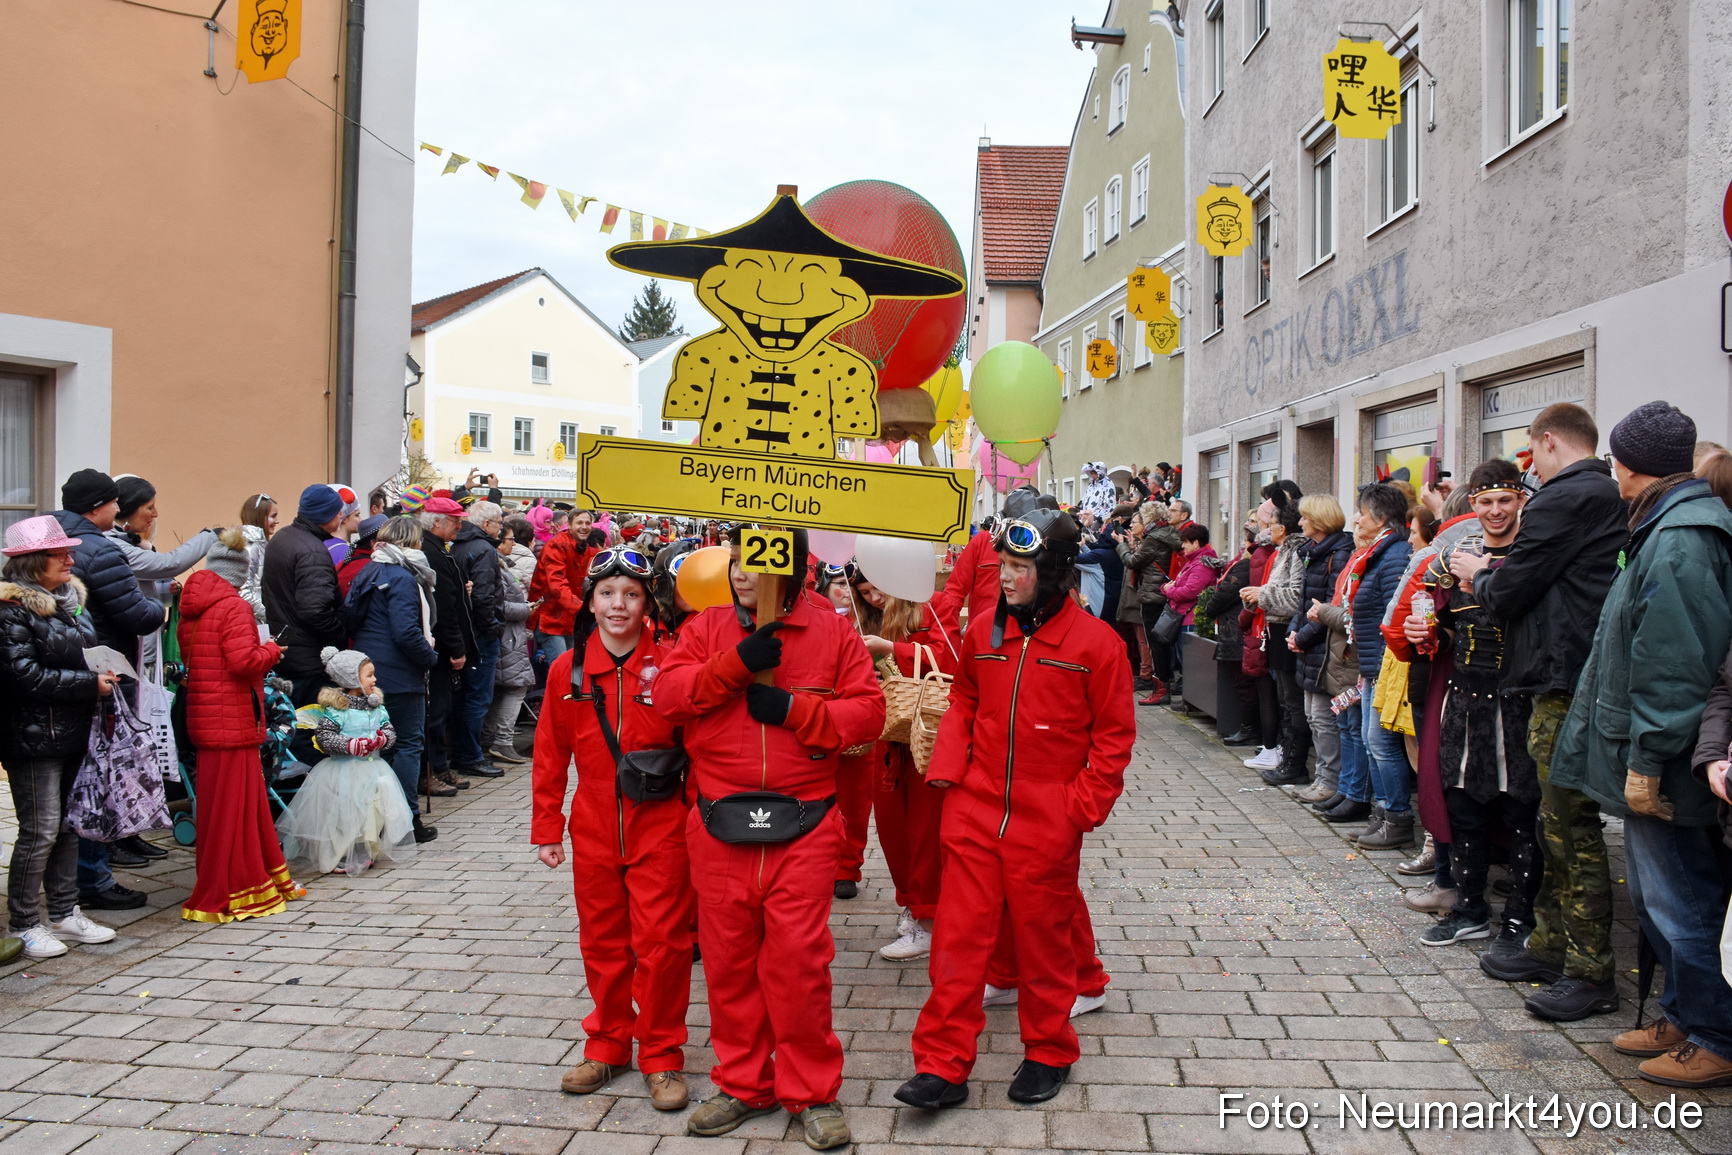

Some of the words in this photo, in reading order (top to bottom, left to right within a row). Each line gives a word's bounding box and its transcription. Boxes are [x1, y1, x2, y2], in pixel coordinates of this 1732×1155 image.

[1332, 92, 1357, 121] 人
[1366, 86, 1397, 120] 华
[1244, 305, 1315, 396] OPTIK
[1320, 249, 1422, 367] OEXL
[680, 456, 756, 483] Bayern
[765, 464, 866, 492] München
[721, 487, 821, 516] Fan-Club
[745, 536, 790, 568] 23
[749, 820, 771, 828] adidas
